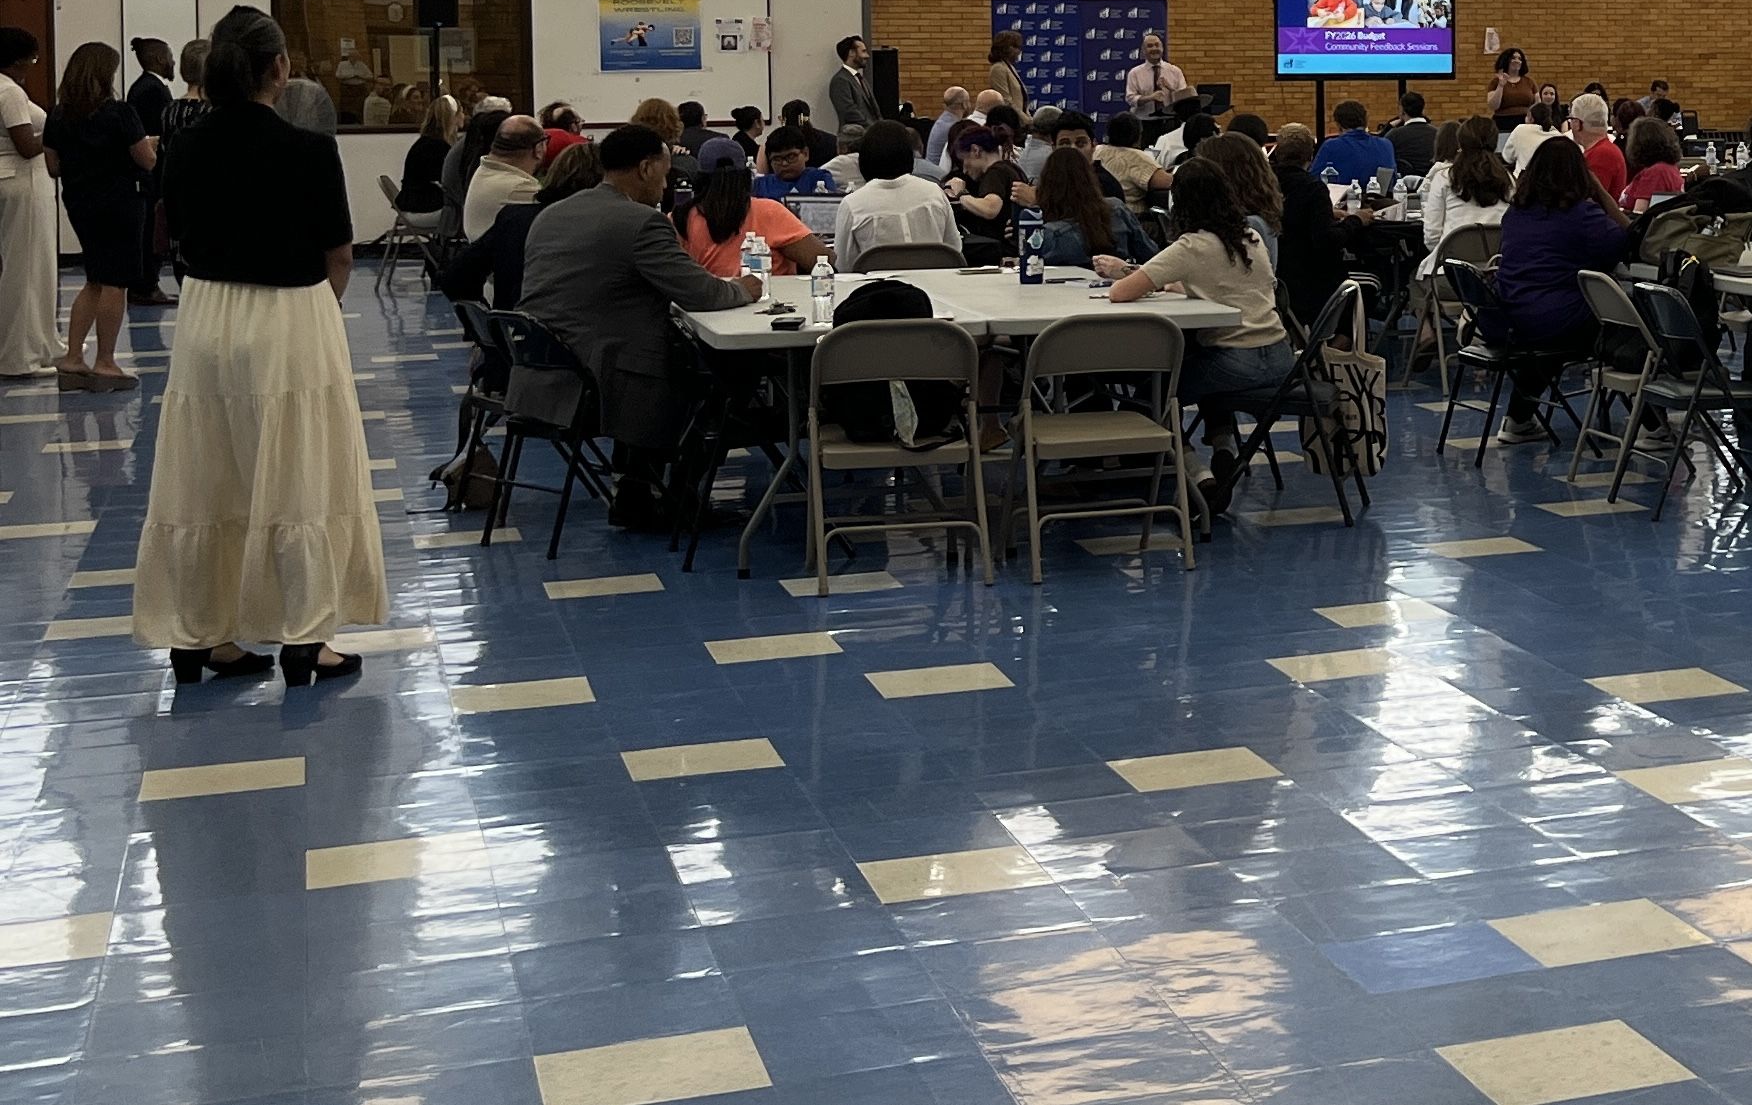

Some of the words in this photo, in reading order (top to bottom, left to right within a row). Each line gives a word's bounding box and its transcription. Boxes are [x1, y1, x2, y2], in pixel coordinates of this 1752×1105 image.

[1324, 31, 1356, 40] FY2026
[1357, 31, 1386, 42] Budget
[1324, 42, 1368, 51] Community
[1370, 42, 1406, 50] Feedback
[1407, 42, 1438, 50] Sessions
